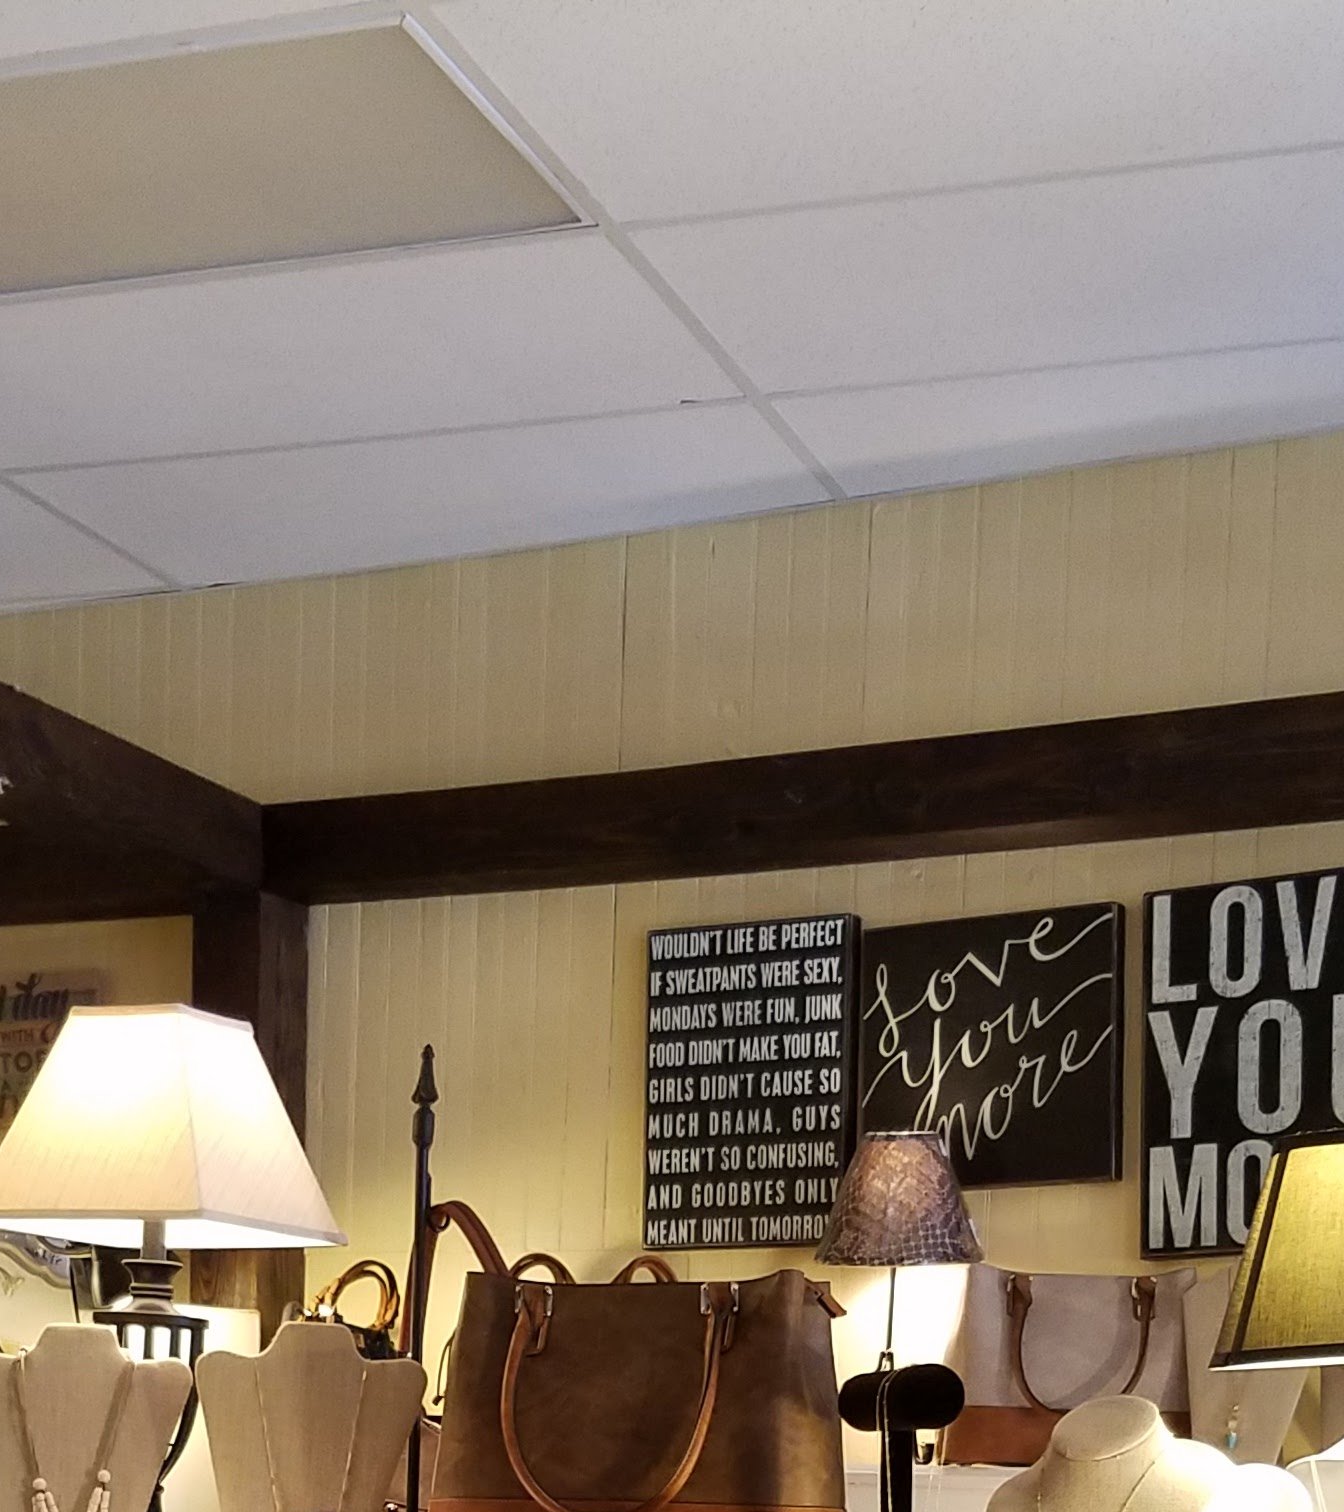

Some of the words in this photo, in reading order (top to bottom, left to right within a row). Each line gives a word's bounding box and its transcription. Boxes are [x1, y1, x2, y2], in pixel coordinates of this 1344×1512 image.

[651, 930, 723, 961] WOULDN'T
[726, 927, 754, 954] LIFE
[758, 925, 777, 952] BE
[781, 919, 845, 950] PERFECT
[650, 971, 662, 997] IF
[666, 964, 757, 995] SWEATPANTS
[760, 960, 800, 988] WERE
[803, 956, 843, 985] SEXY,
[649, 1003, 717, 1033] MONDAYS
[722, 1000, 762, 1027] WERE
[766, 997, 800, 1024] FUN,
[804, 993, 842, 1023] JUNK
[0, 1030, 34, 1044] WITH
[649, 1042, 685, 1069] FOOD
[688, 1039, 735, 1066] DIDN'T
[738, 1037, 779, 1062] MAKE
[783, 1034, 811, 1059] YOU
[814, 1031, 841, 1059] FAT,
[649, 1077, 694, 1104] GIRLS
[700, 1073, 754, 1101] DIDN'T
[760, 1069, 813, 1097] CAUSE
[819, 1067, 841, 1094] SO
[648, 1112, 699, 1139] MUCH
[709, 1107, 781, 1137] DRAMA,
[792, 1104, 841, 1132] GUYS
[648, 1147, 715, 1175] WEREN'T
[720, 1146, 741, 1171] SO
[747, 1141, 839, 1170] CONFUSING,
[647, 1184, 682, 1210] AND
[691, 1179, 786, 1209] GOODBYES
[794, 1177, 838, 1204] ONLY
[1149, 1140, 1272, 1250] MO
[647, 1218, 697, 1245] MEANT
[702, 1217, 744, 1243] UNTIL
[750, 1214, 829, 1241] TOMORRO
